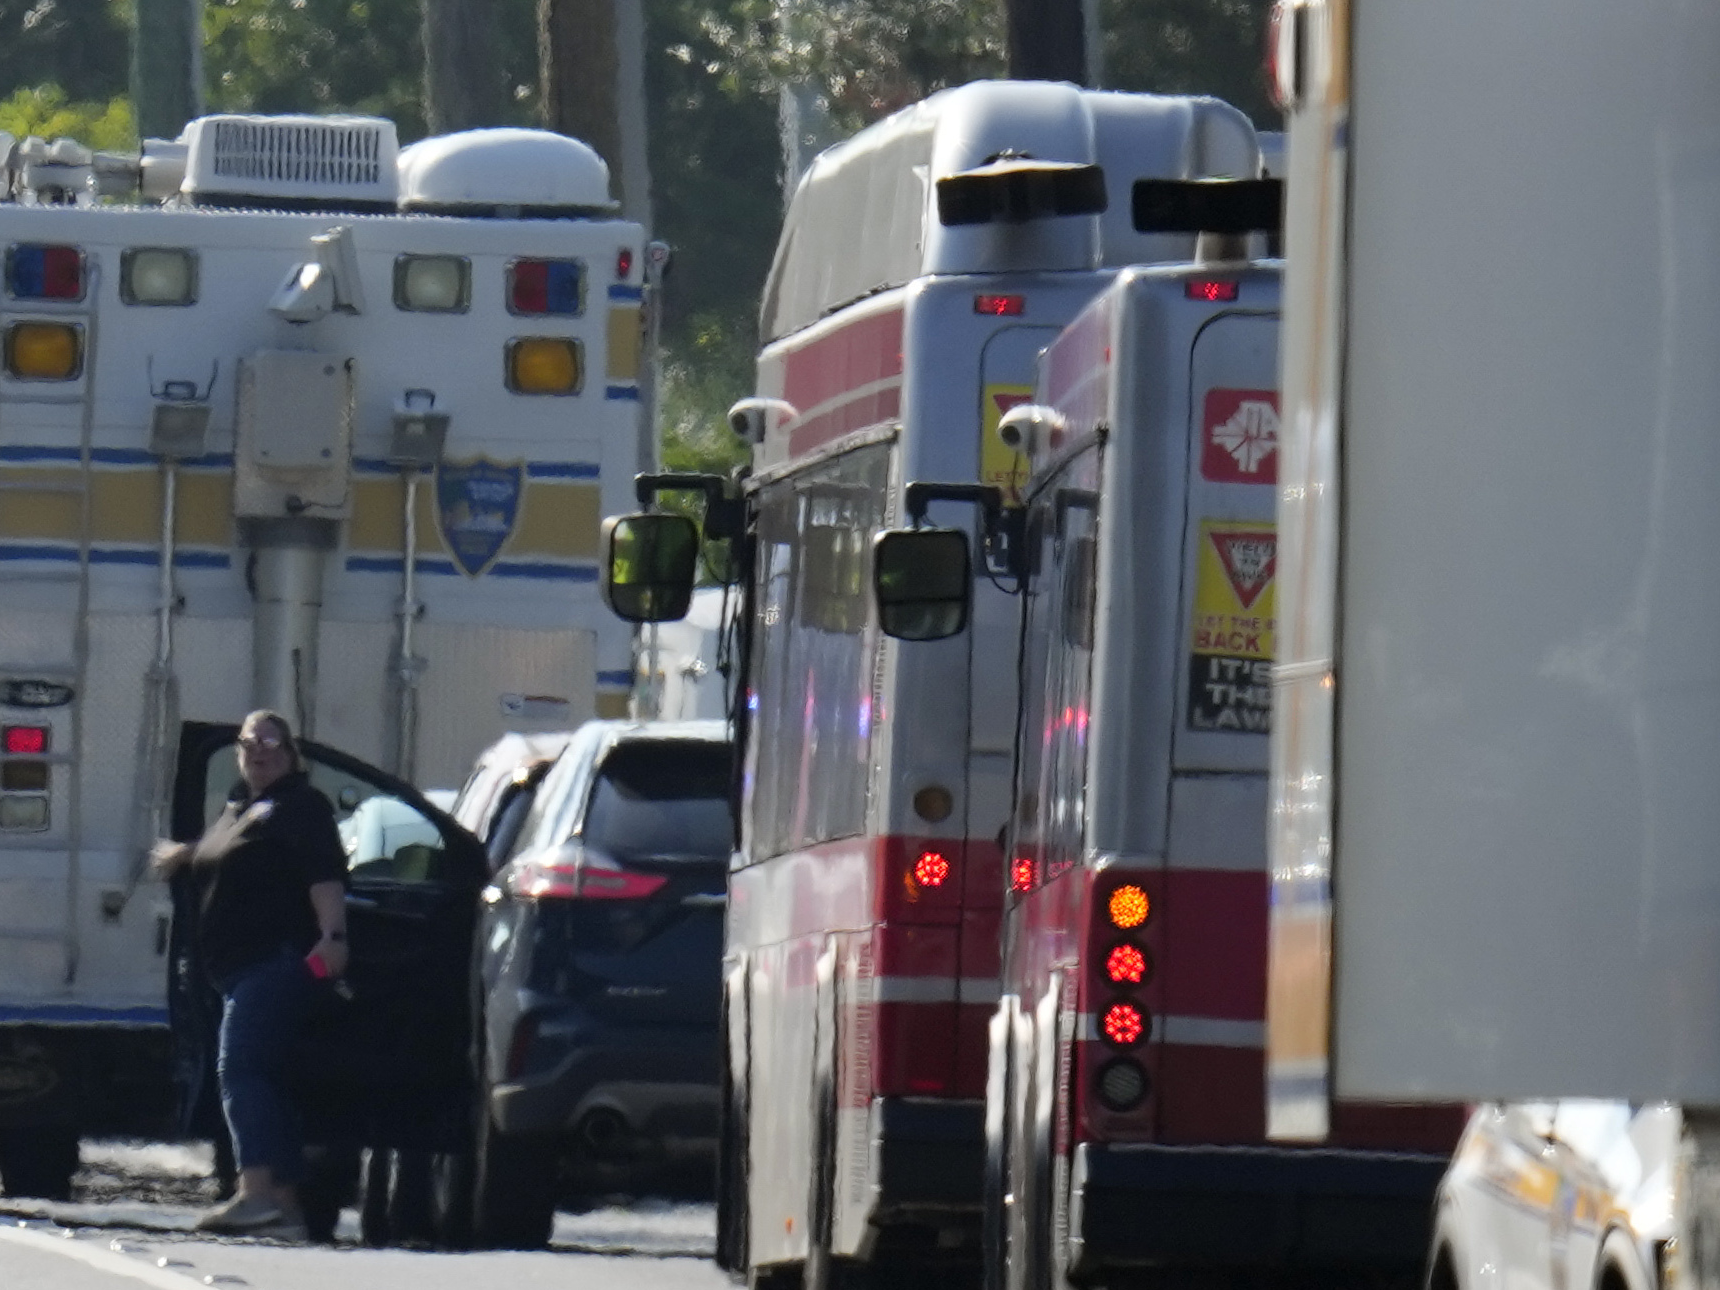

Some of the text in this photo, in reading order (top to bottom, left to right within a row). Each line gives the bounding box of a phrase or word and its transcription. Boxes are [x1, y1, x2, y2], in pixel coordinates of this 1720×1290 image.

[1230, 615, 1261, 630] THE
[1195, 630, 1261, 652] BACK
[1209, 657, 1273, 685] IT'S
[1204, 683, 1273, 706] THE
